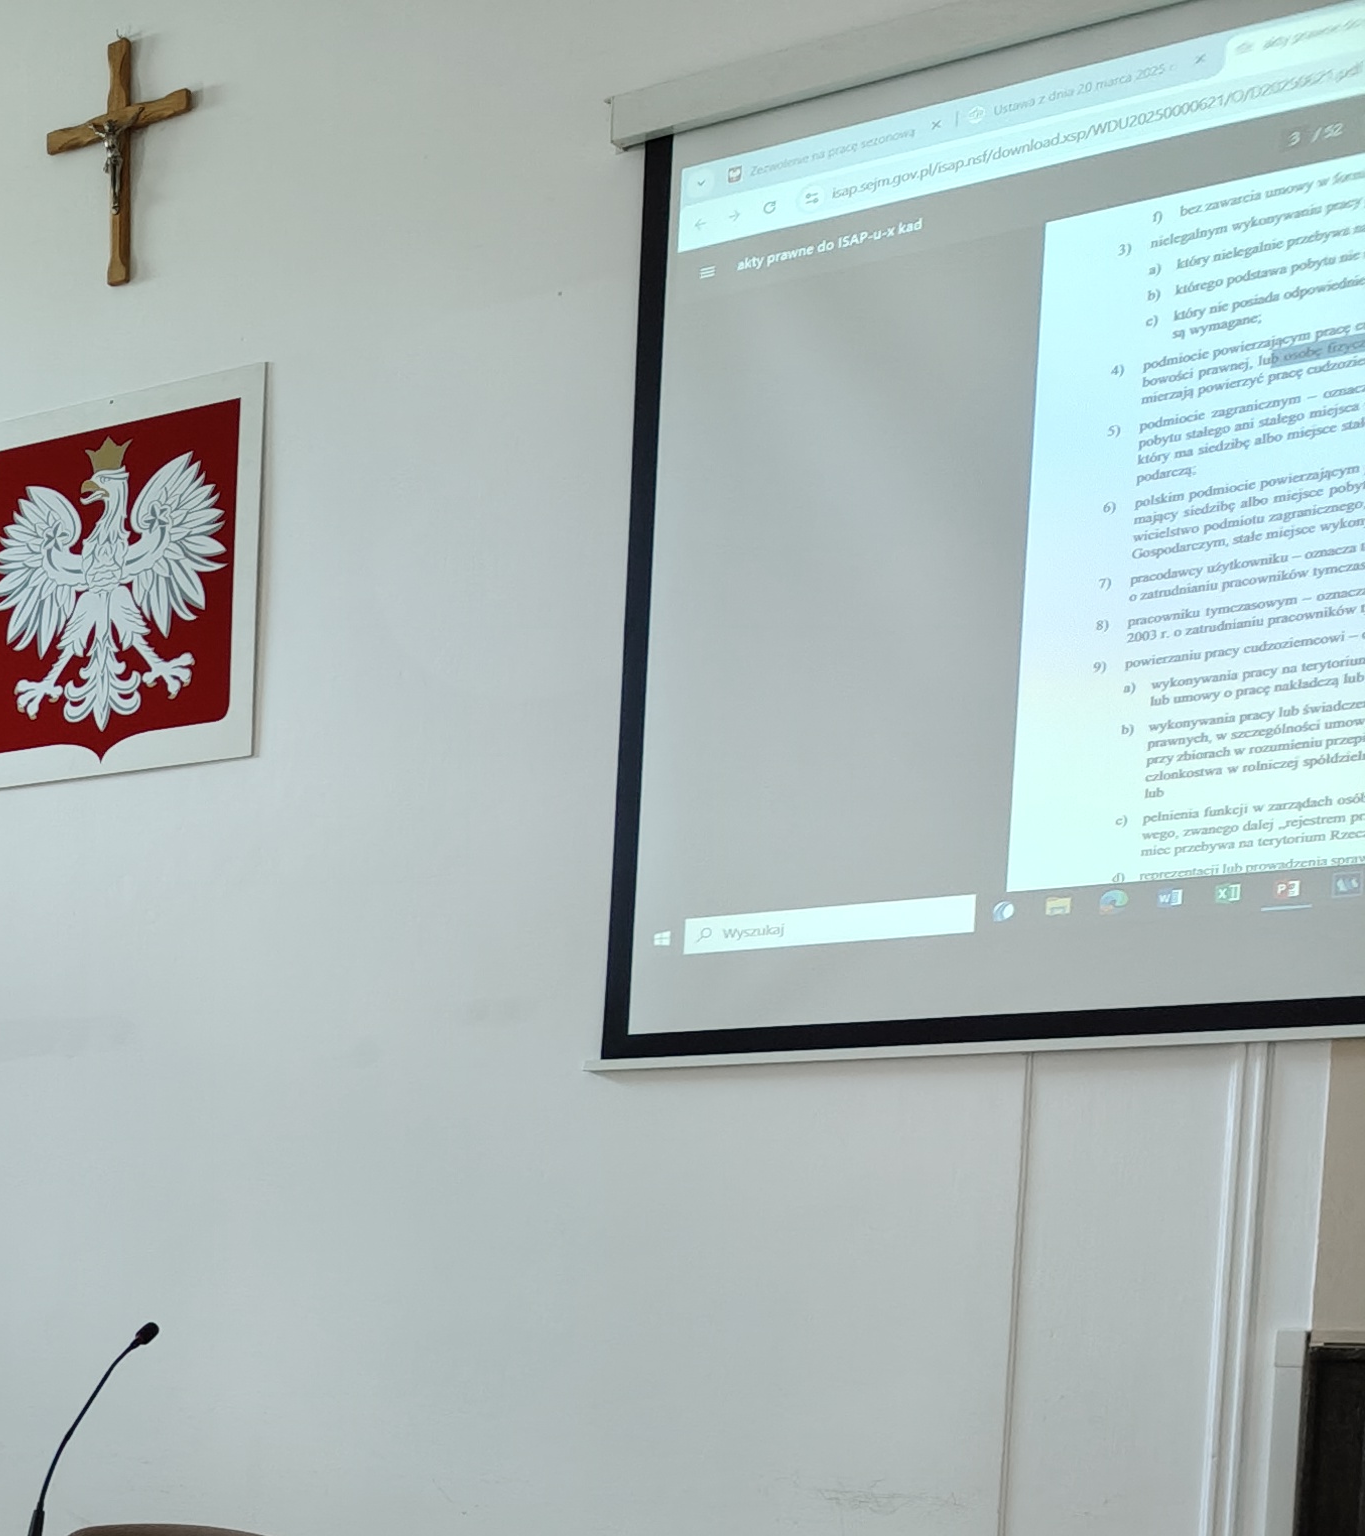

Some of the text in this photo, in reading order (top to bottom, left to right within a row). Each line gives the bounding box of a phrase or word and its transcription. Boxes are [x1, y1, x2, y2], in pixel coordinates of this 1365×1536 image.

[994, 99, 1035, 115] Ustawa
[1049, 88, 1073, 102] dnia
[1077, 81, 1092, 95] 20
[1096, 75, 1131, 90] marca
[813, 152, 825, 161] na
[828, 145, 857, 160] pracę
[1180, 203, 1201, 216] bez
[1265, 182, 1313, 198] umowy
[737, 218, 923, 271] akty prawne do ISAP-u-x kad
[1118, 241, 1132, 257] 3)
[1151, 225, 1227, 248] nielegalnym
[1149, 261, 1161, 277] a)
[1176, 255, 1209, 269] który
[1213, 239, 1283, 262] nielegalnie
[1147, 286, 1161, 302] b)
[1175, 278, 1222, 294] którego
[1227, 267, 1286, 288] podstawa
[1291, 255, 1336, 276] pobytu
[1146, 291, 1279, 328] c) który nie posiada
[1172, 311, 1262, 339] są wymagane;
[1111, 326, 1350, 378] 4) podmiocie powierzającym pracę
[1142, 367, 1193, 386] bowości
[1199, 357, 1253, 380] prawnej,
[1258, 351, 1277, 365] lub
[1141, 368, 1303, 403] mierzają powierzyć pracę
[1108, 396, 1301, 437] 5) podmiocie zagranicznym
[1139, 404, 1359, 450] pobytu stałego ani stałego miejsca
[1138, 426, 1336, 464] który ma siedzibę albo miejsce
[1103, 466, 1360, 514] 6) polskim podmiocie powierzającym
[1134, 488, 1323, 525] mający siedzibę albo miejsce
[1132, 522, 1199, 541] wicielstwo
[1203, 513, 1264, 534] podmiotu
[1132, 525, 1315, 559] Gospodarczym, stałe miejsce
[1099, 544, 1357, 591] 7) pracodawcy użytkowniku oznacza
[1129, 567, 1308, 601] o zatrudnianiu pracowników
[1096, 596, 1297, 633] 8) pracowniku tymczasowym
[1127, 604, 1355, 642] 2003 r. o zatrudnianiu pracowników
[1094, 630, 1344, 674] 9) powierzaniu pracy cudzoziemcowi
[1124, 665, 1297, 695] a) wykonywania pracy na
[1151, 671, 1365, 705] lub umowy o pracę nakładczą lub
[1121, 705, 1299, 737] b) wykonywania pracy lub
[1147, 730, 1211, 752] prawnych,
[1231, 719, 1320, 739] szczególności
[1145, 756, 1299, 781] członkostwa w rolniczej
[1146, 737, 1322, 768] przy zbiorach w rozumieniu
[1145, 785, 1164, 798] lub
[1116, 795, 1332, 830] c) pełnienia funkcji w zarządach
[1142, 830, 1179, 842] wego,
[1183, 824, 1238, 837] zwanego
[1243, 817, 1273, 833] dalej
[1140, 830, 1325, 857] miec przebywa na terytorium
[1223, 861, 1241, 874] lub
[1246, 855, 1327, 873] prowadzenia
[722, 923, 785, 941] Wyszukaj
